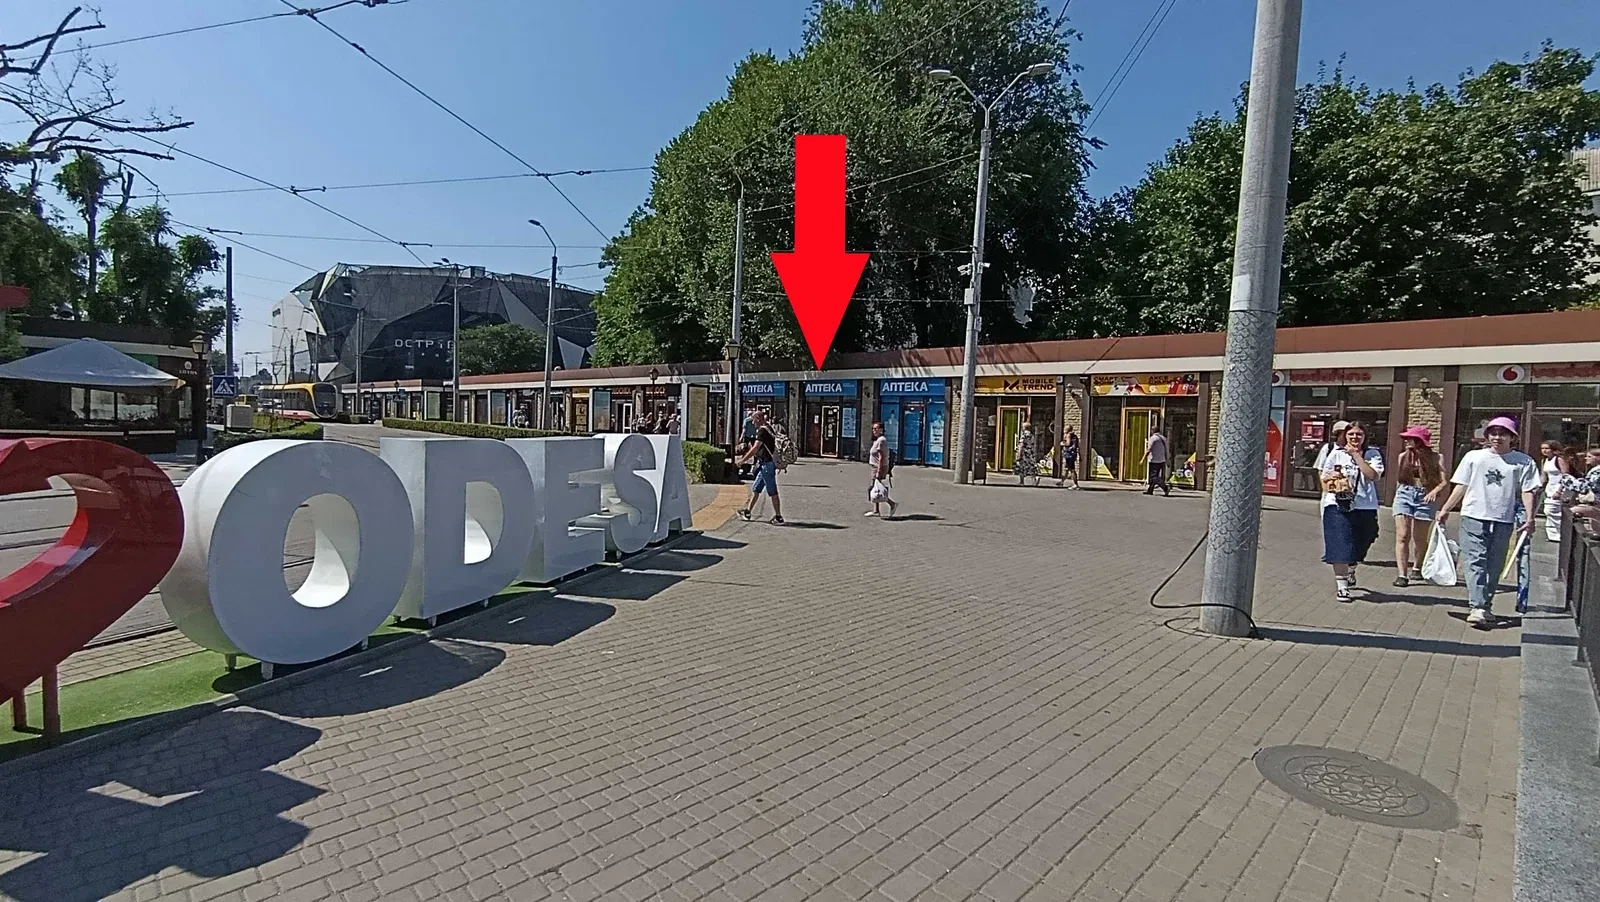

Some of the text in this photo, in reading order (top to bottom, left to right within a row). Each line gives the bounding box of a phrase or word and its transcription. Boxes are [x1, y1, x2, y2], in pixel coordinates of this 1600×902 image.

[742, 384, 773, 393] АПТЕКА
[805, 383, 843, 393] АПТЕКА
[882, 381, 929, 392] АПТЕКА
[162, 433, 693, 664] ODESA
